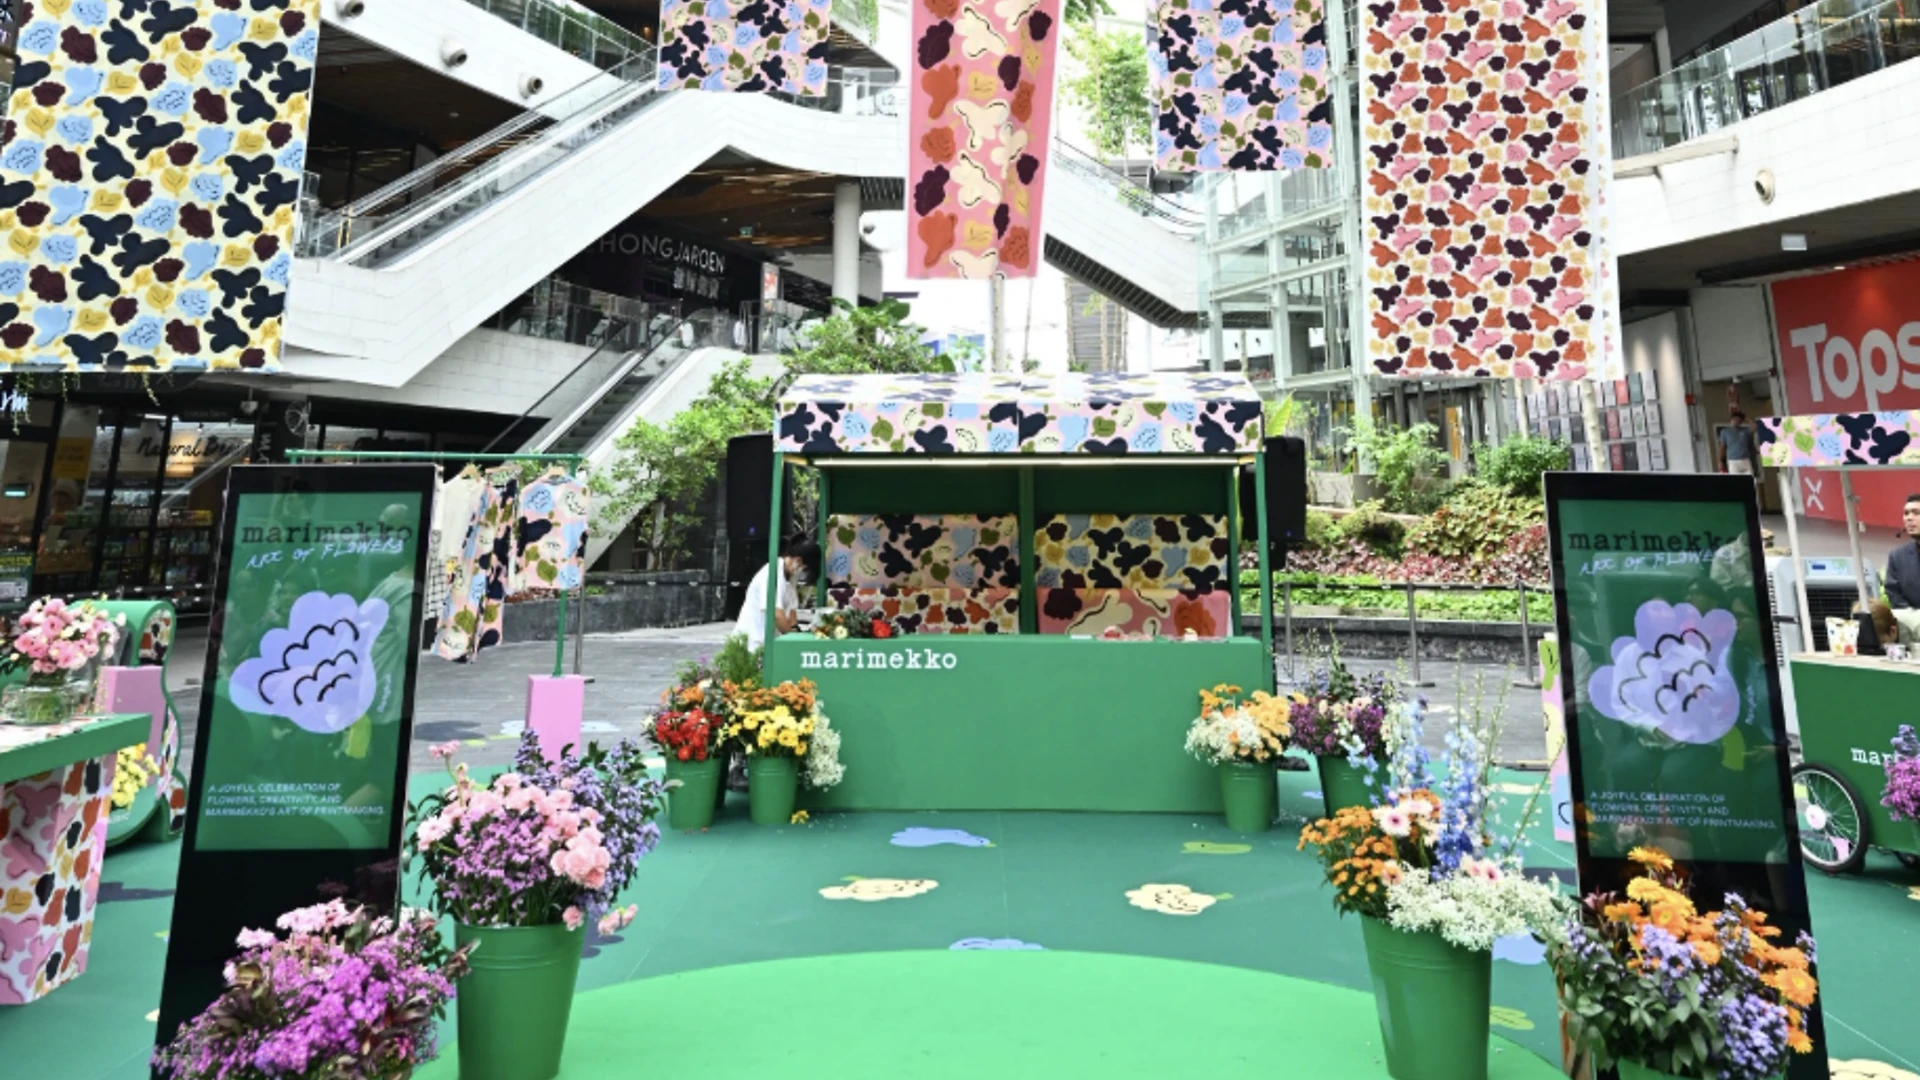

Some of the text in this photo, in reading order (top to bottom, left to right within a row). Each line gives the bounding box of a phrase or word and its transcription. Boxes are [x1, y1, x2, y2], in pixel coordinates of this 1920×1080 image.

[588, 232, 726, 274] HONGJAROEN
[1789, 321, 1920, 413] Tops
[241, 521, 413, 543] marimekko
[320, 537, 404, 560] FLOWERS
[800, 648, 957, 669] marimekko
[208, 783, 342, 793] A JOYFUL CELEBRATION OF
[320, 795, 342, 804] AND
[1590, 791, 1726, 803] A JOYFUL CELEBRATION OF
[278, 806, 298, 816] ART
[300, 806, 313, 816] OF
[1707, 806, 1729, 816] AND
[1665, 816, 1685, 826] ART
[1687, 816, 1701, 827] OF
